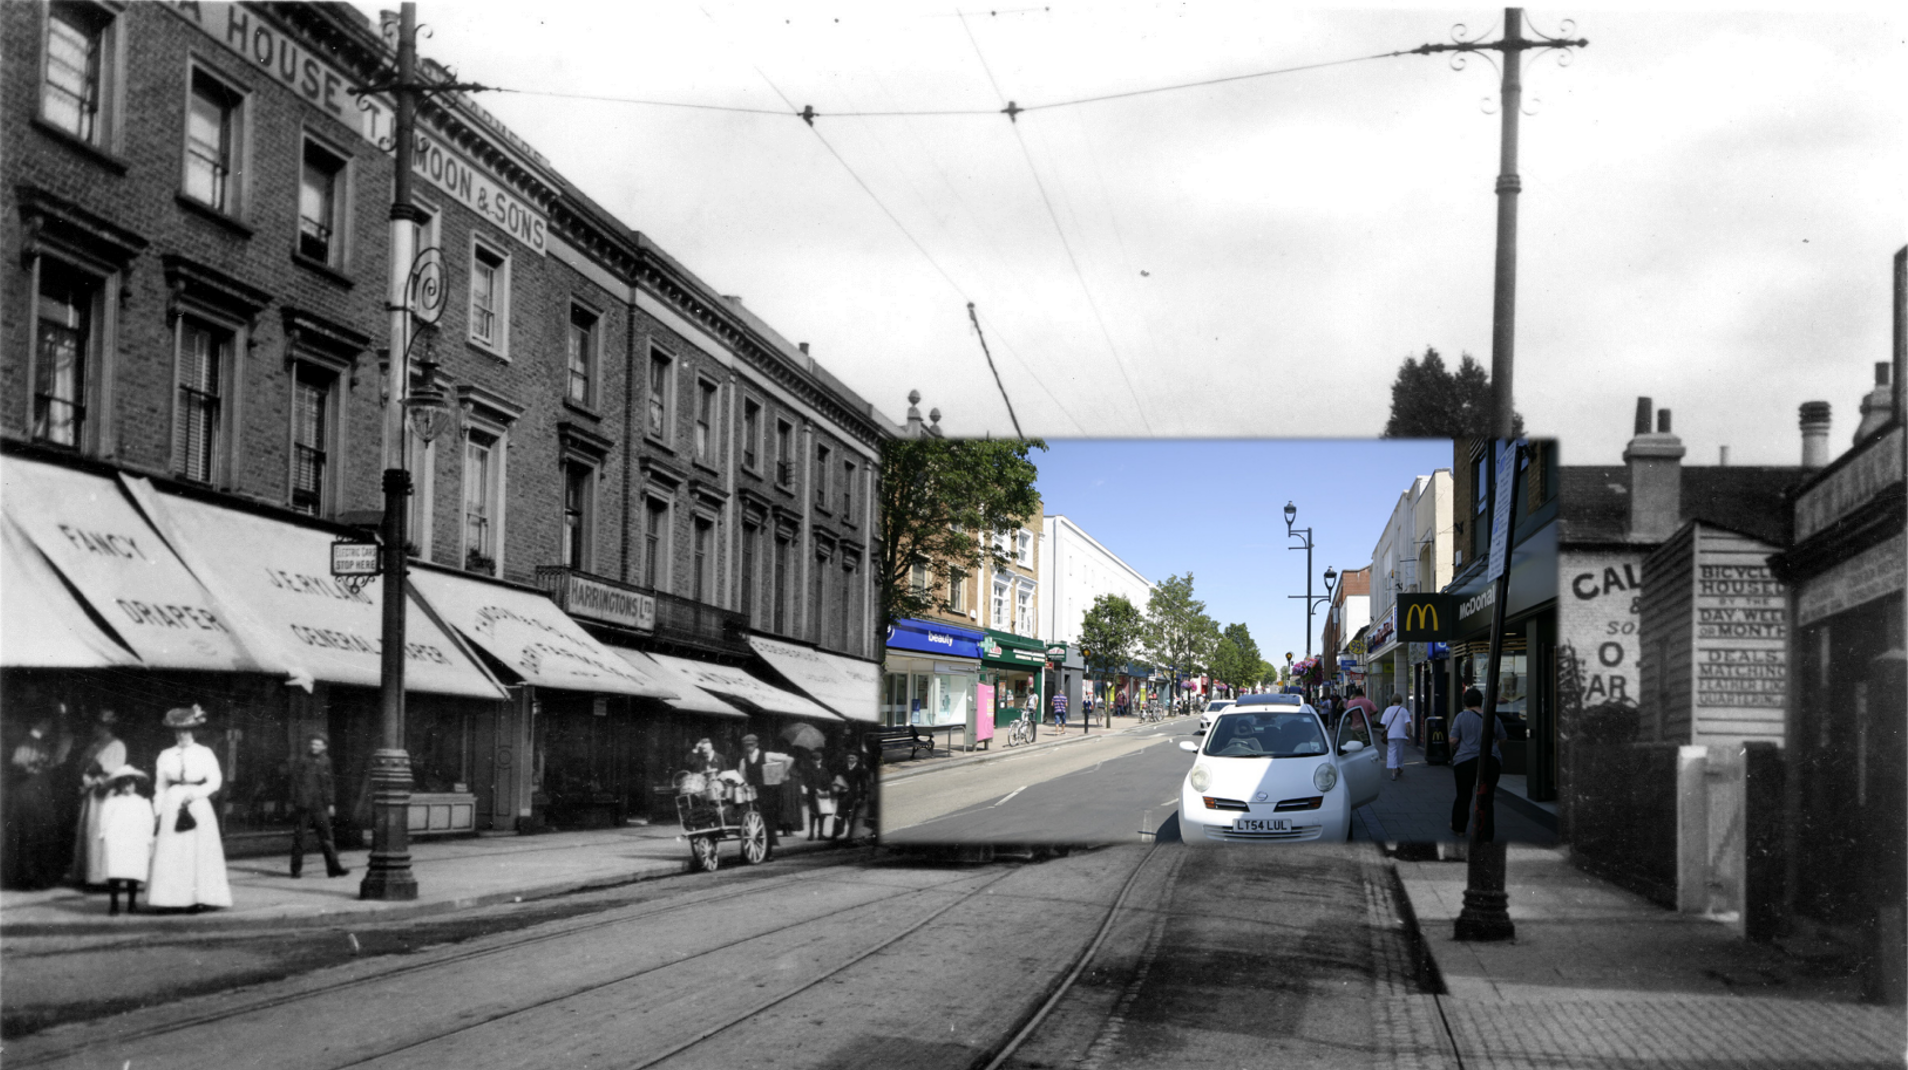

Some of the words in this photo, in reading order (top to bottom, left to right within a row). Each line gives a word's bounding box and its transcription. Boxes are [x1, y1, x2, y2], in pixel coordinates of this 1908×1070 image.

[228, 5, 342, 115] HOUSE
[412, 131, 472, 203] MOON
[477, 187, 490, 216] &
[495, 193, 545, 250] SONS
[58, 524, 146, 560] FANCY
[335, 560, 354, 570] STOP
[356, 560, 376, 570] HERE
[1702, 567, 1772, 579] BICYCL
[571, 579, 637, 617] HARRINGTONS
[1459, 584, 1497, 620] McDonal
[1719, 597, 1734, 605] BY
[1746, 597, 1769, 605] THE
[116, 599, 230, 633] DRAPER
[1606, 621, 1641, 635] SO
[290, 623, 382, 655] GENERAL
[928, 630, 953, 647] beauty
[1237, 820, 1264, 831] LT54
[1267, 820, 1287, 831] LUL
